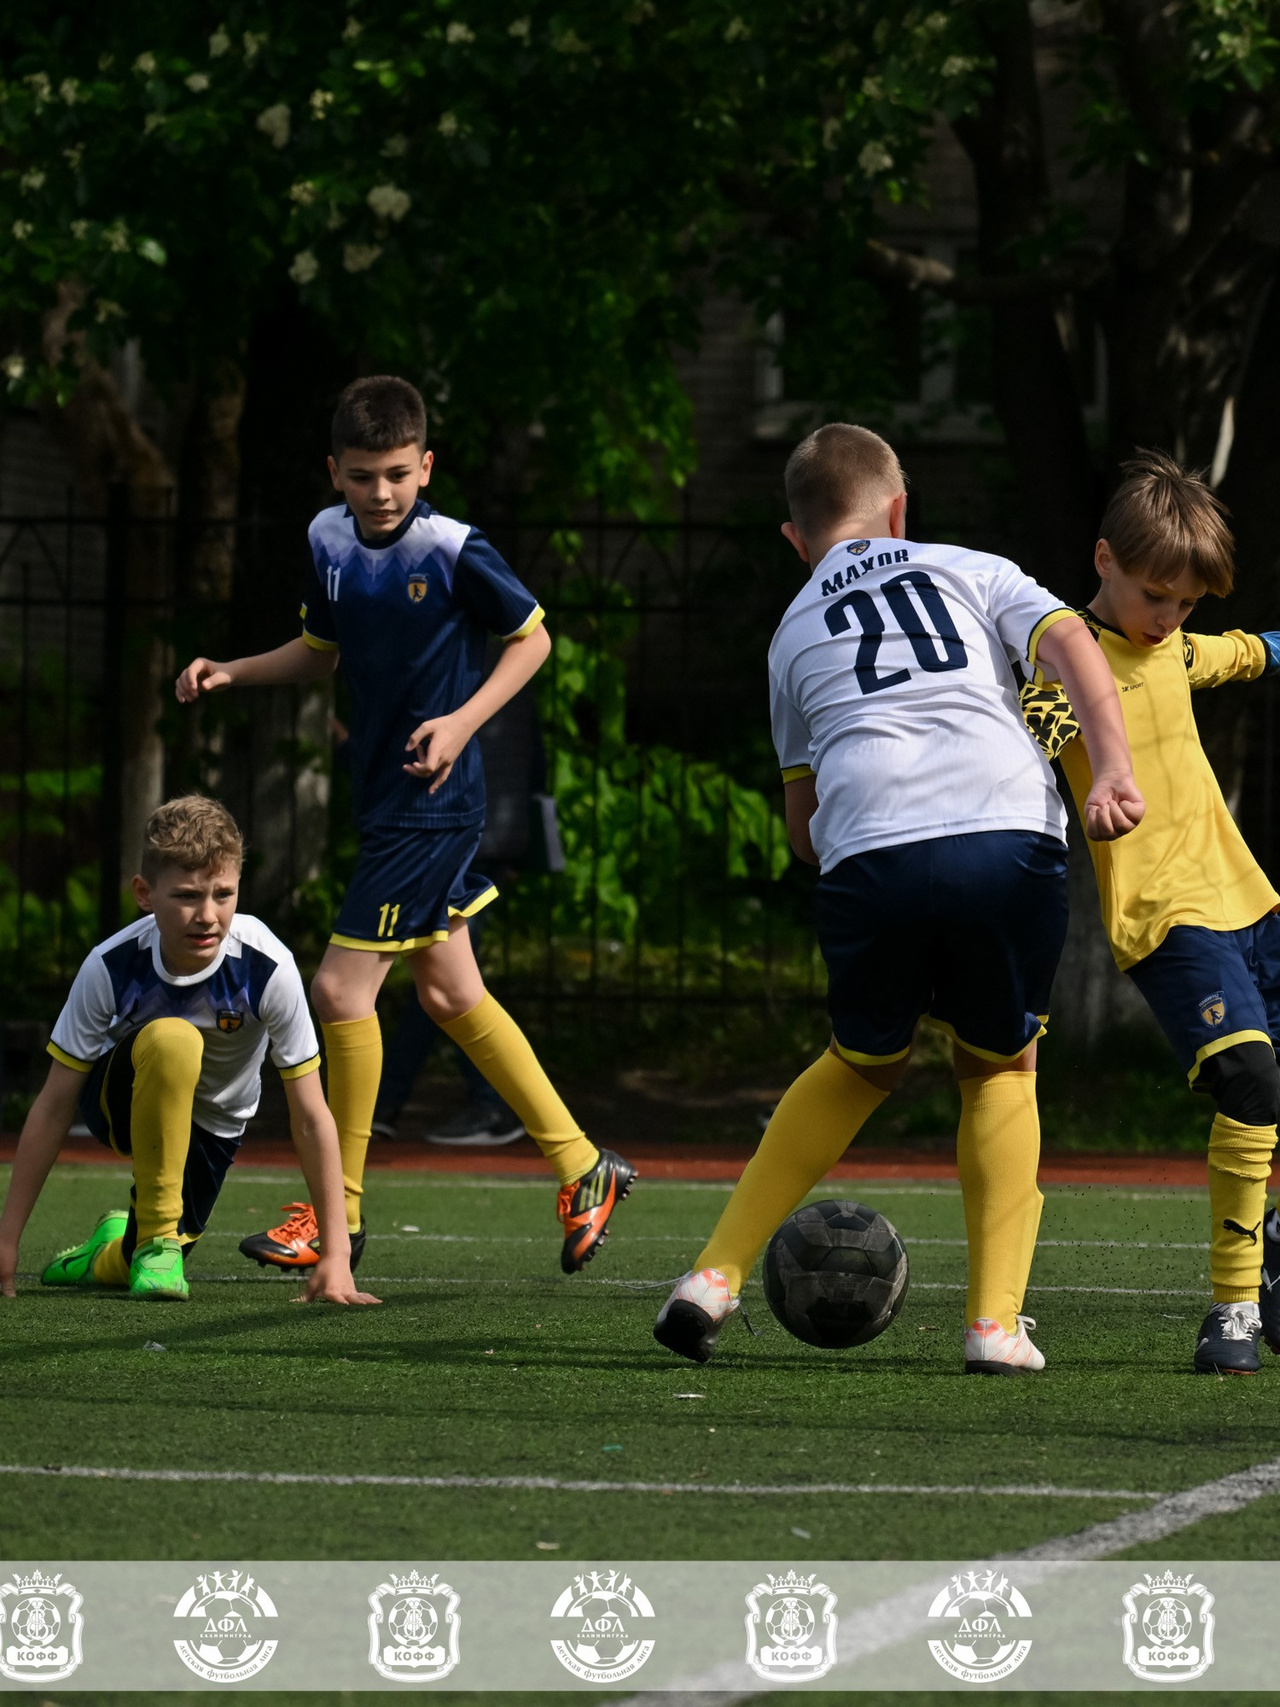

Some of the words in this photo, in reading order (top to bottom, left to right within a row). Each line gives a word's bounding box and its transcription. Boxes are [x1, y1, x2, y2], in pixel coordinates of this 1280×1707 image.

[327, 565, 341, 602] 11
[823, 571, 968, 695] 20
[1130, 682, 1144, 690] SPORT
[377, 903, 400, 937] 11
